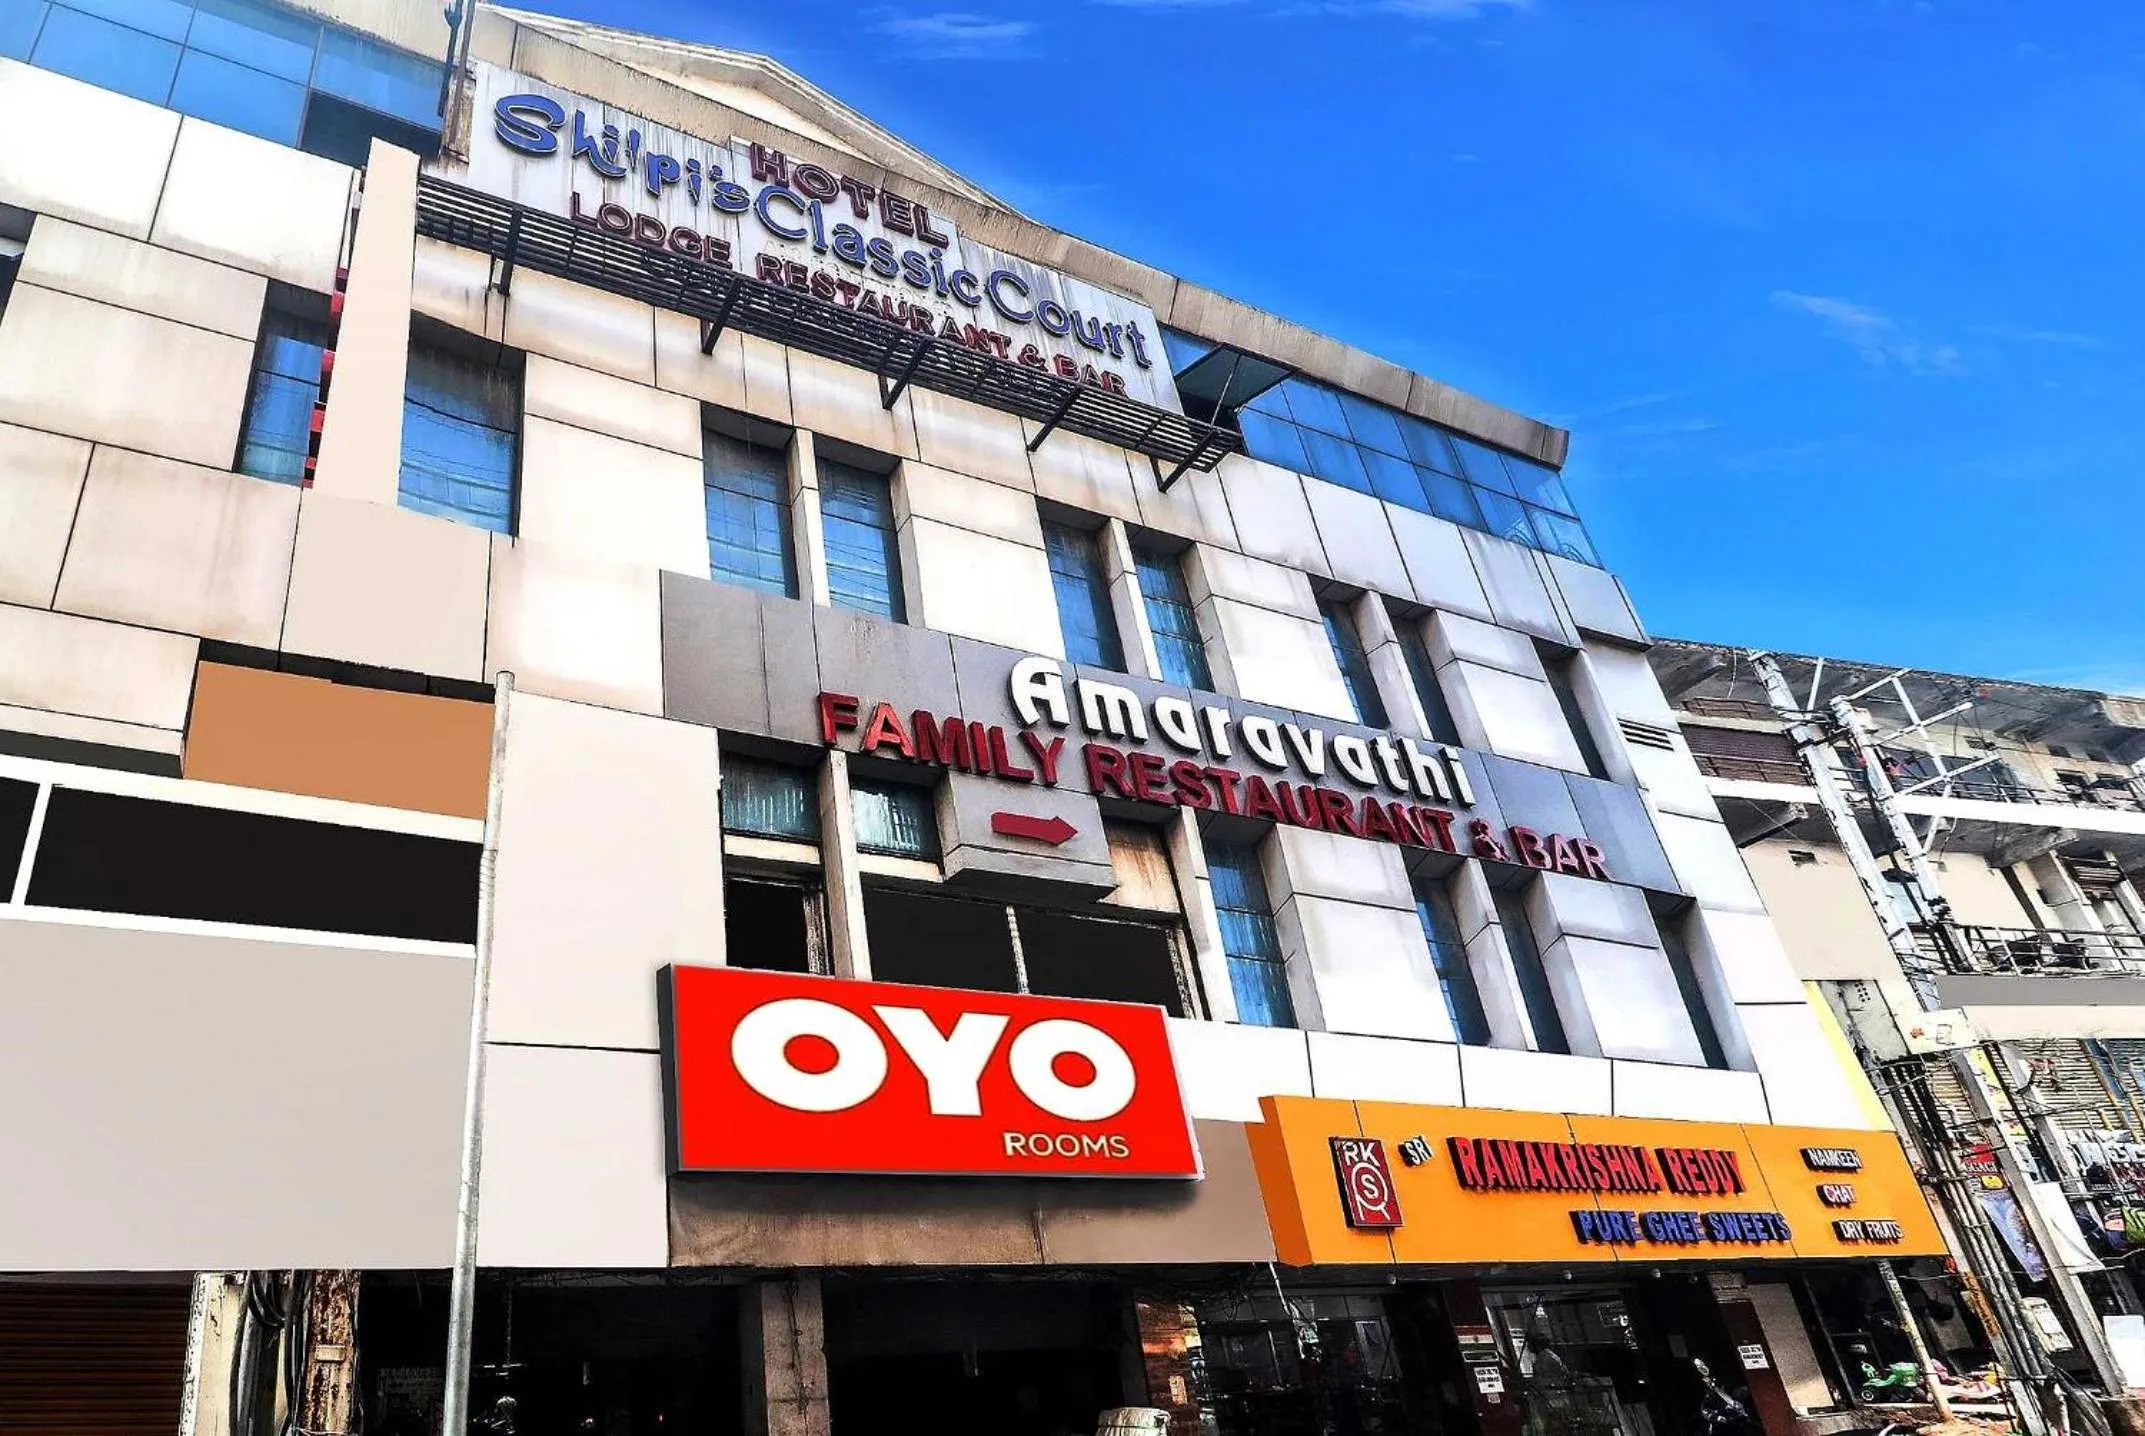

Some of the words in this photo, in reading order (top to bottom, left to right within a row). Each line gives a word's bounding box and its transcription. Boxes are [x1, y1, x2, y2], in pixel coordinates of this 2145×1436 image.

[750, 141, 949, 249] HOTEL
[571, 191, 733, 269] LODGE
[757, 253, 1011, 360] RESTAURANT
[1018, 343, 1048, 373] &
[1053, 353, 1128, 397] BAR
[987, 270, 1153, 370] Court
[1008, 656, 1477, 808] Amaravathi
[818, 690, 1066, 786] FAMILY
[1082, 743, 1459, 854] RESTAURANT
[1468, 816, 1512, 862] &
[1509, 823, 1611, 882] BAR
[730, 997, 1137, 1123] OYO
[1003, 1131, 1130, 1159] ROOMS
[1343, 1141, 1380, 1166] RK
[1403, 1136, 1434, 1165] SRI
[1454, 1137, 1663, 1190] RAMAKRISHNA
[1661, 1148, 1746, 1194] REDDY
[1806, 1149, 1863, 1168] NAMKEEN
[1821, 1184, 1856, 1204] CHAT
[1575, 1210, 1641, 1243] PURE
[1645, 1211, 1702, 1243] GHEE
[1706, 1211, 1792, 1243] SWEETS
[1838, 1220, 1864, 1240] DRY
[1864, 1220, 1905, 1240] FRUITS
